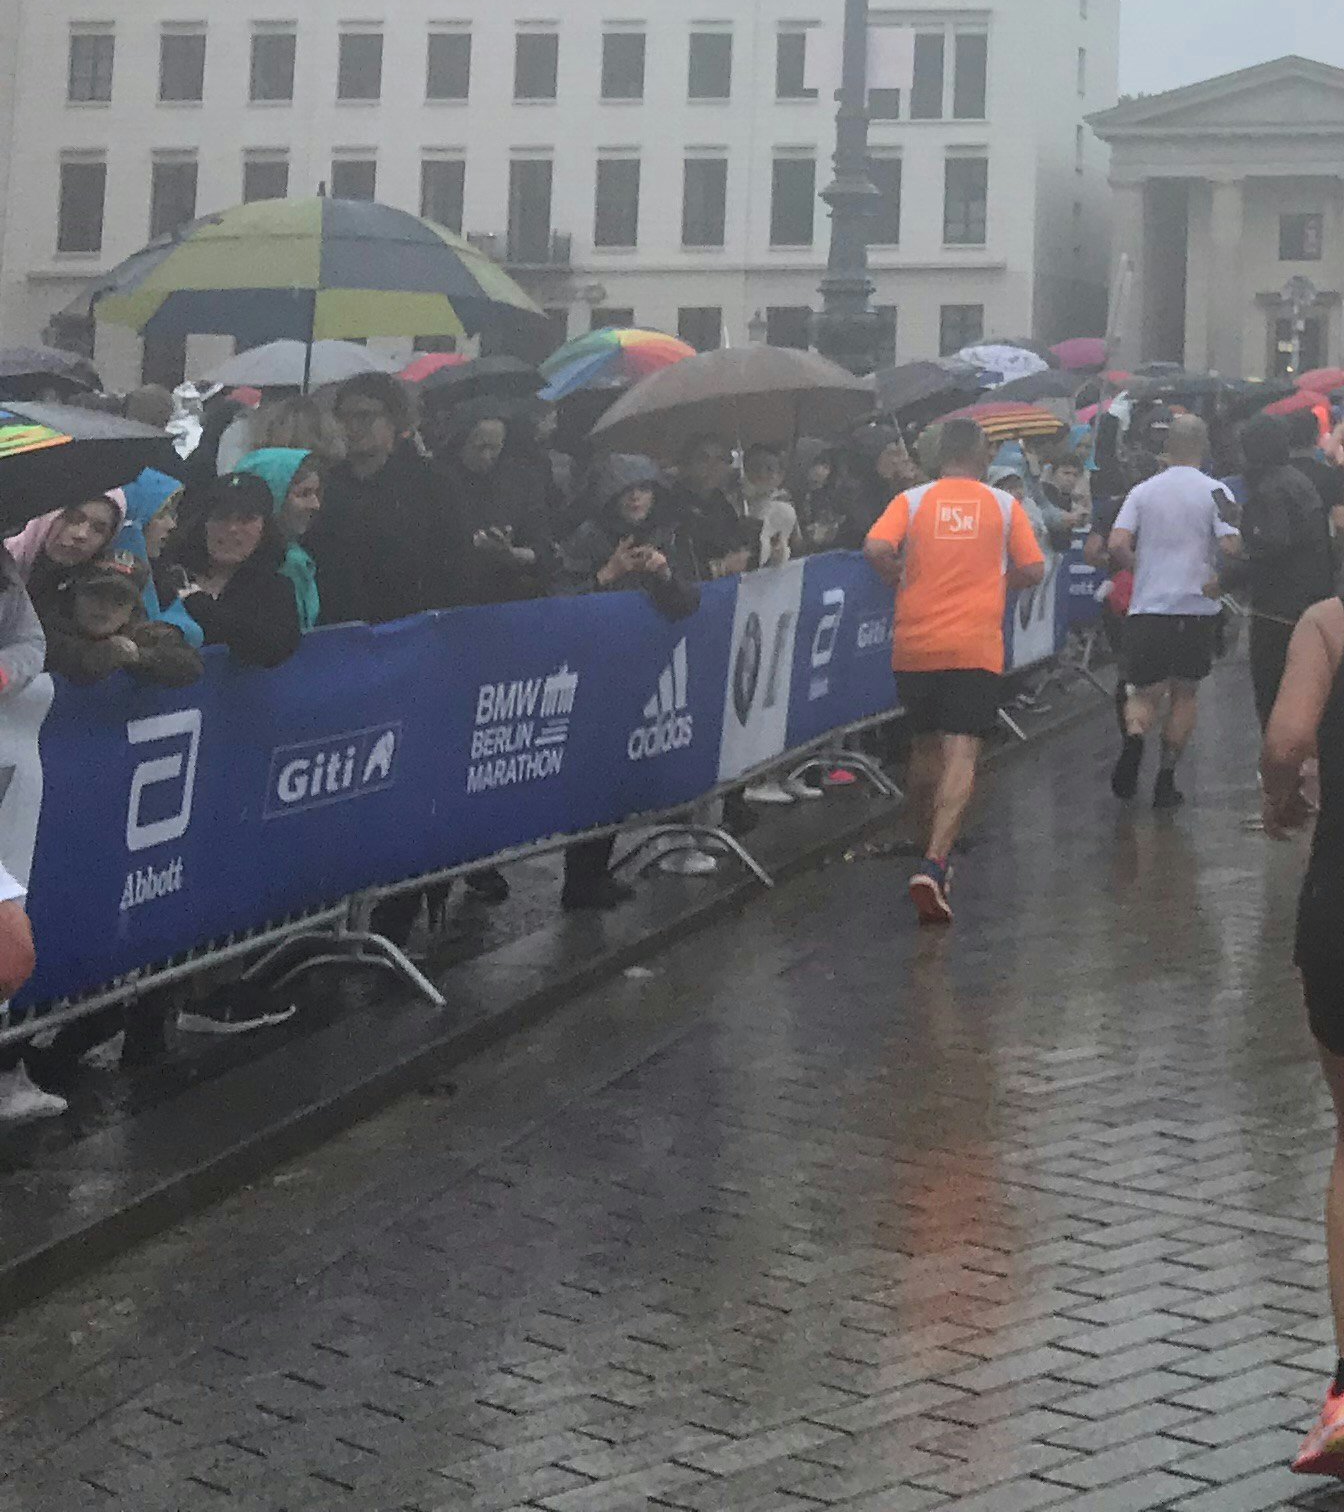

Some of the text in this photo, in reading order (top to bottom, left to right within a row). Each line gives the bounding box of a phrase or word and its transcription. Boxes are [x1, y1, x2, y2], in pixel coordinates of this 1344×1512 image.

[475, 678, 543, 725] BMW
[470, 722, 535, 760] BERLIN
[628, 710, 693, 761] adidas
[277, 745, 356, 803] Giti
[466, 746, 565, 794] MARATHON
[120, 856, 183, 911] Abbott
